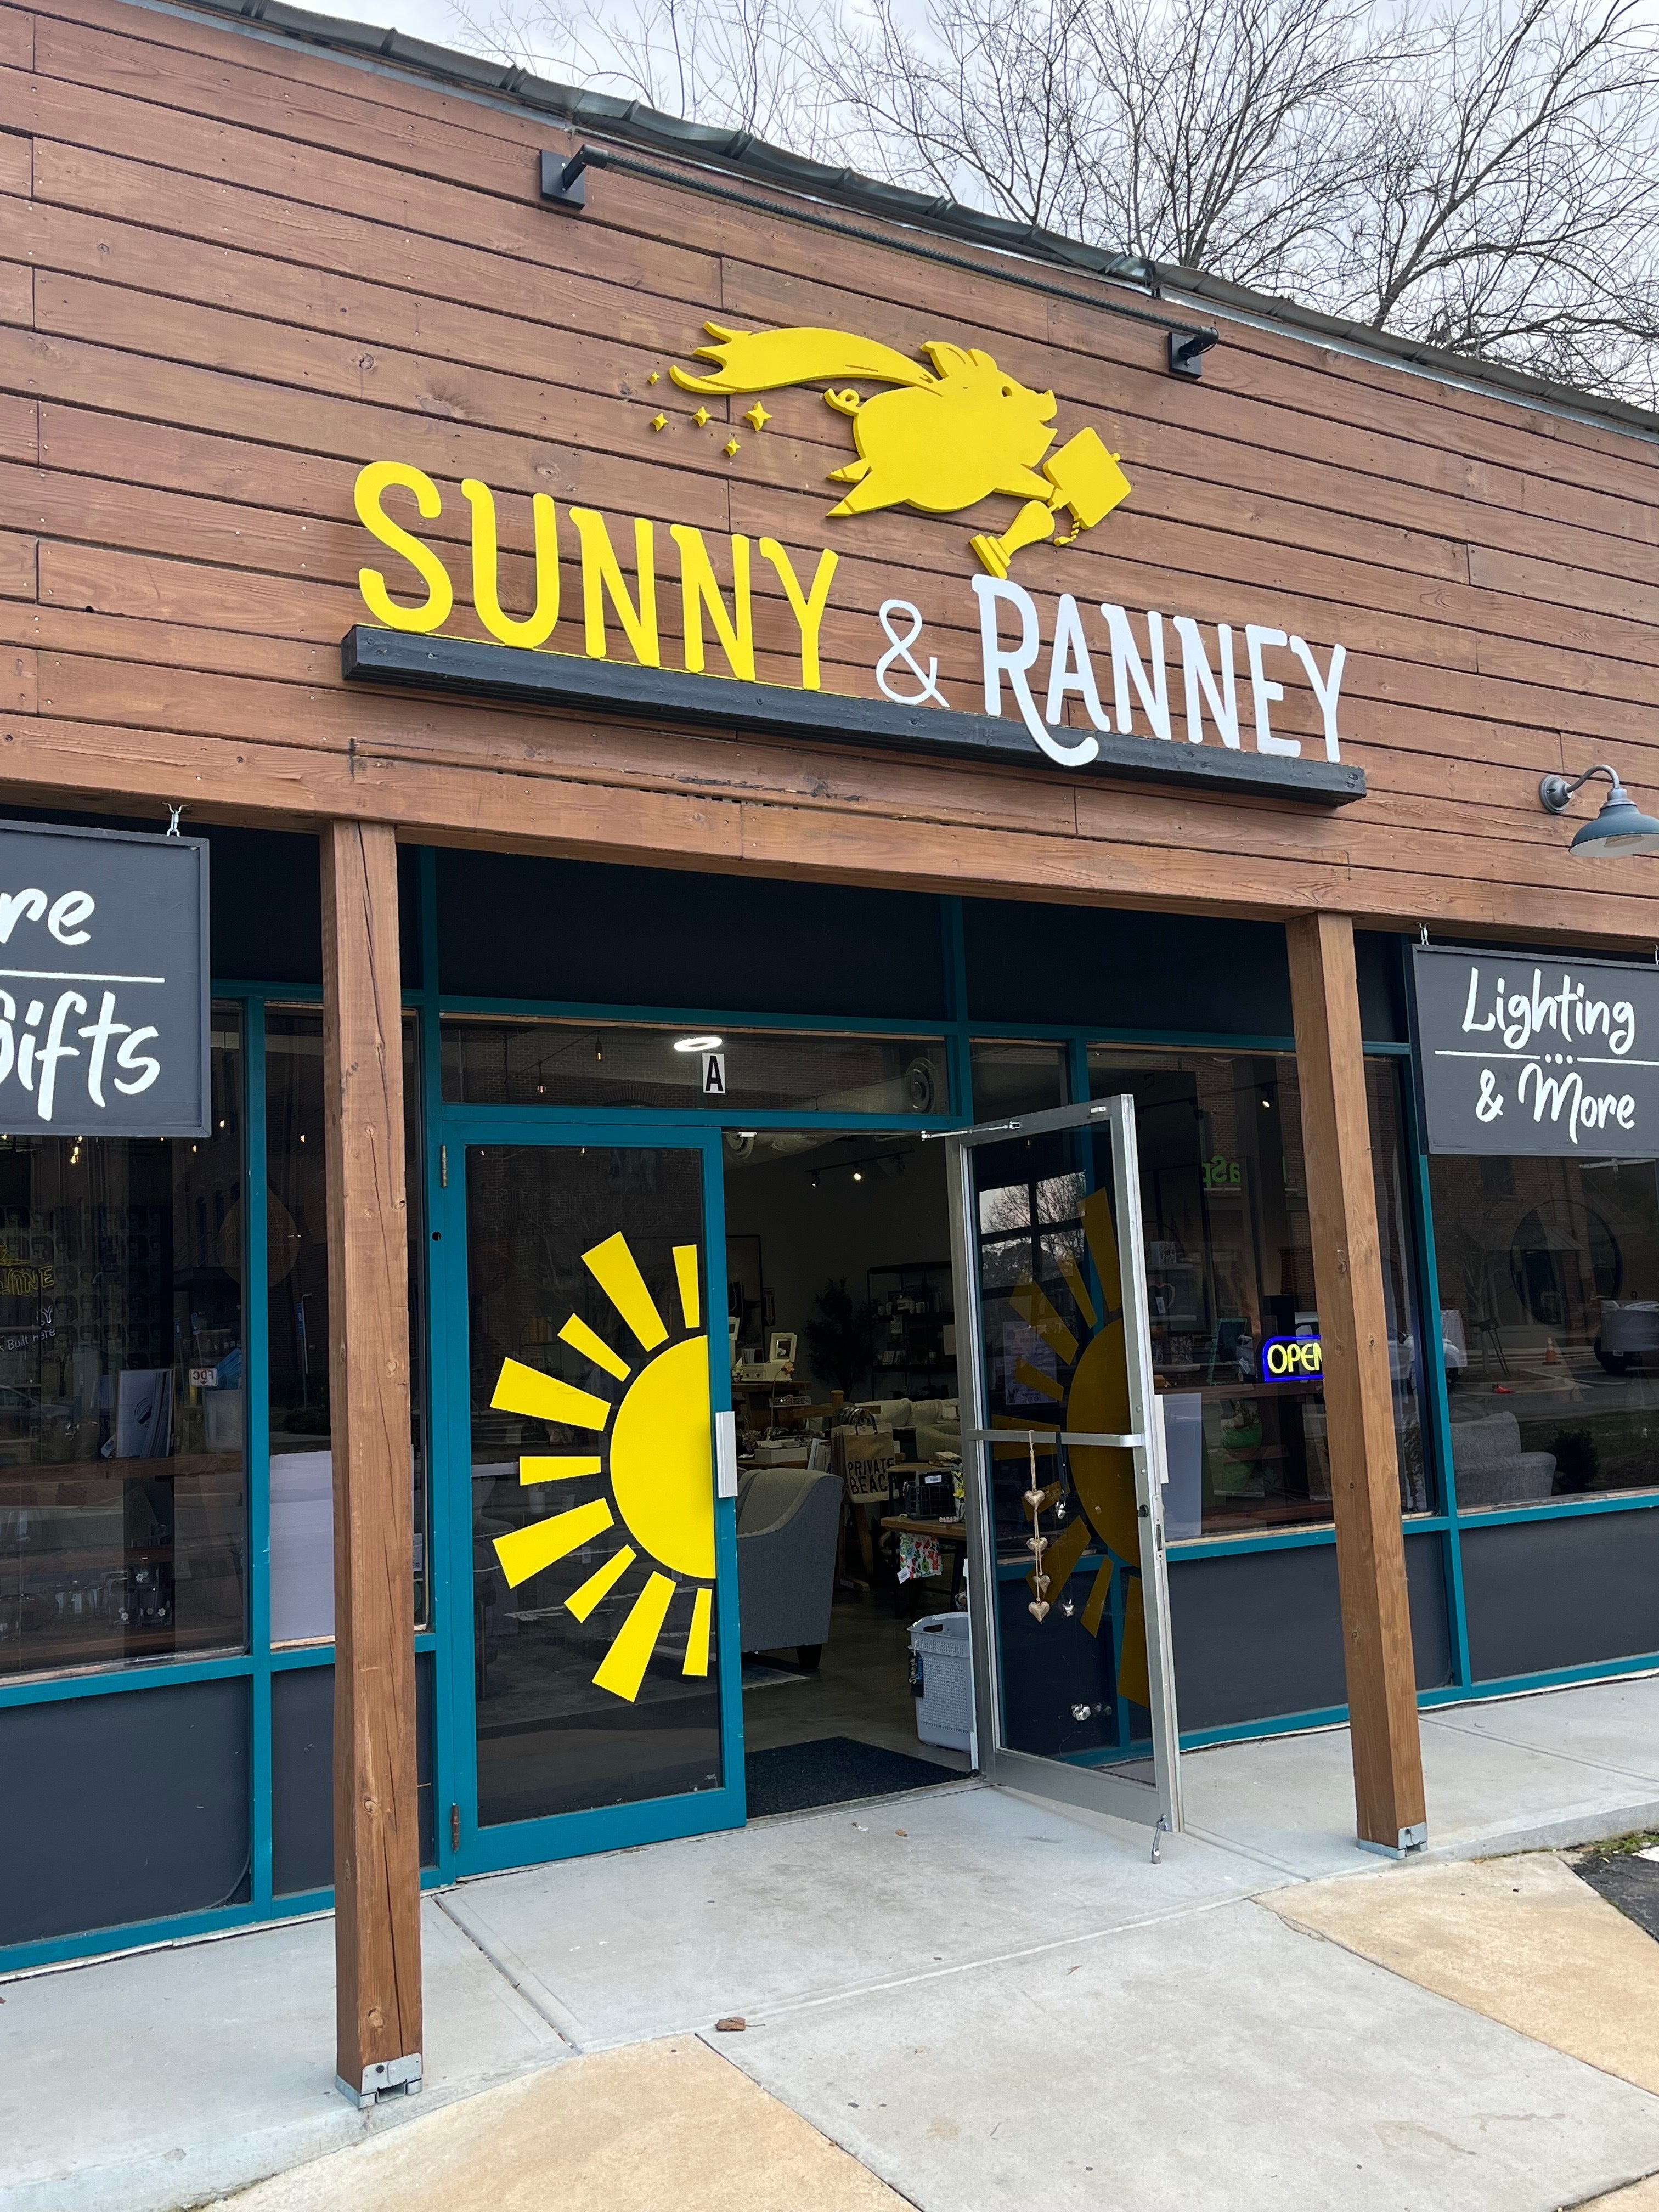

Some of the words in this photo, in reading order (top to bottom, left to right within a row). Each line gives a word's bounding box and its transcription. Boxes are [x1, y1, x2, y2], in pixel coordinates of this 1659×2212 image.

[353, 460, 839, 691] SUNNY
[876, 599, 950, 707] &
[972, 573, 1346, 766] RANNEY
[1462, 967, 1635, 1055] Lighting
[706, 1056, 724, 1091] A
[1476, 1069, 1504, 1122] &
[1518, 1062, 1635, 1144] More
[1267, 1343, 1323, 1374] OPEN
[848, 1458, 895, 1476] PRIVATE
